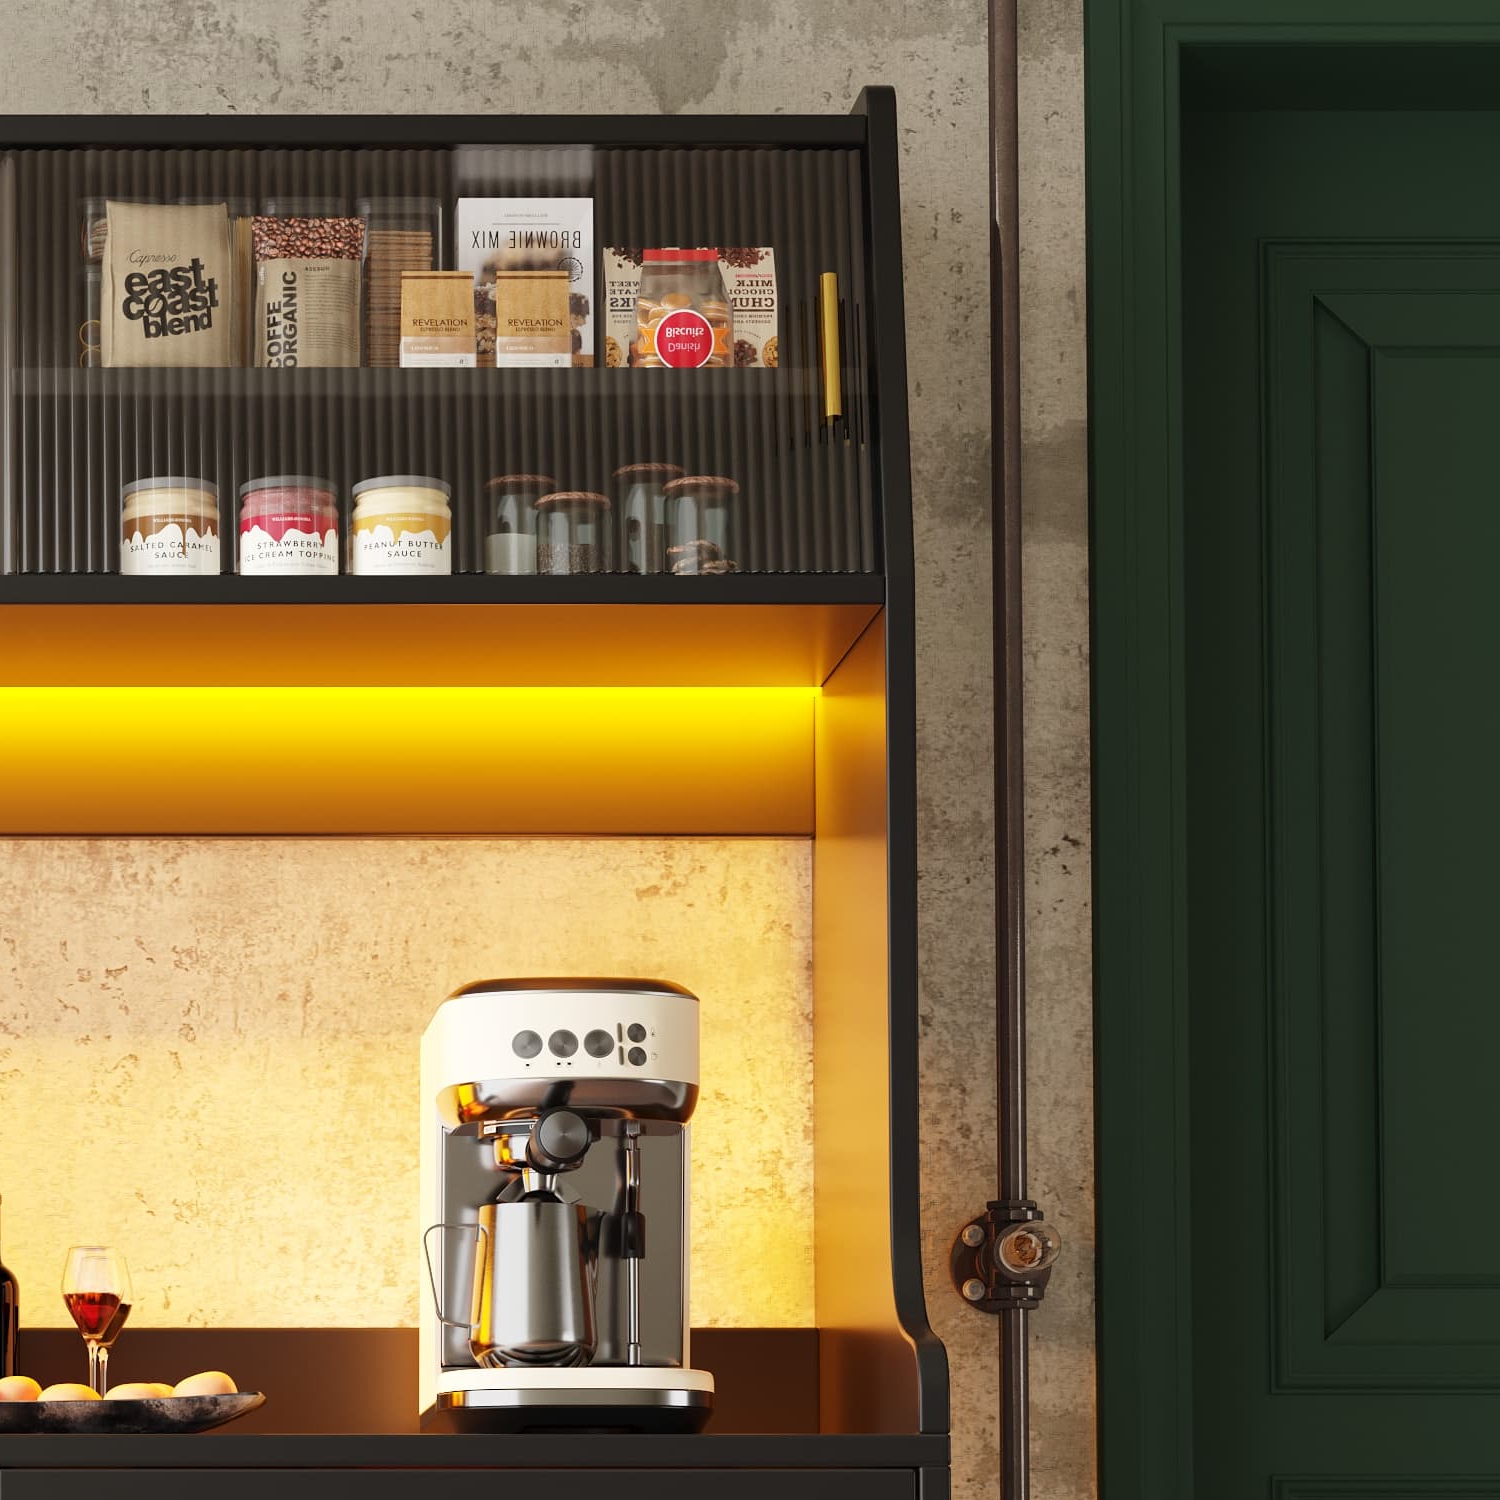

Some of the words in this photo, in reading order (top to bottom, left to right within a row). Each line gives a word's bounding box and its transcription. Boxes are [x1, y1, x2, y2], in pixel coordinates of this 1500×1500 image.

[124, 257, 205, 296] east
[122, 278, 219, 320] coast
[142, 306, 213, 339] blend
[282, 271, 298, 368] ORGANIC
[412, 318, 468, 327] REVELATION
[507, 318, 563, 327] REVELATION
[130, 541, 165, 553] SALTED
[258, 551, 293, 559] CREAM
[387, 550, 423, 558] SAUCE
